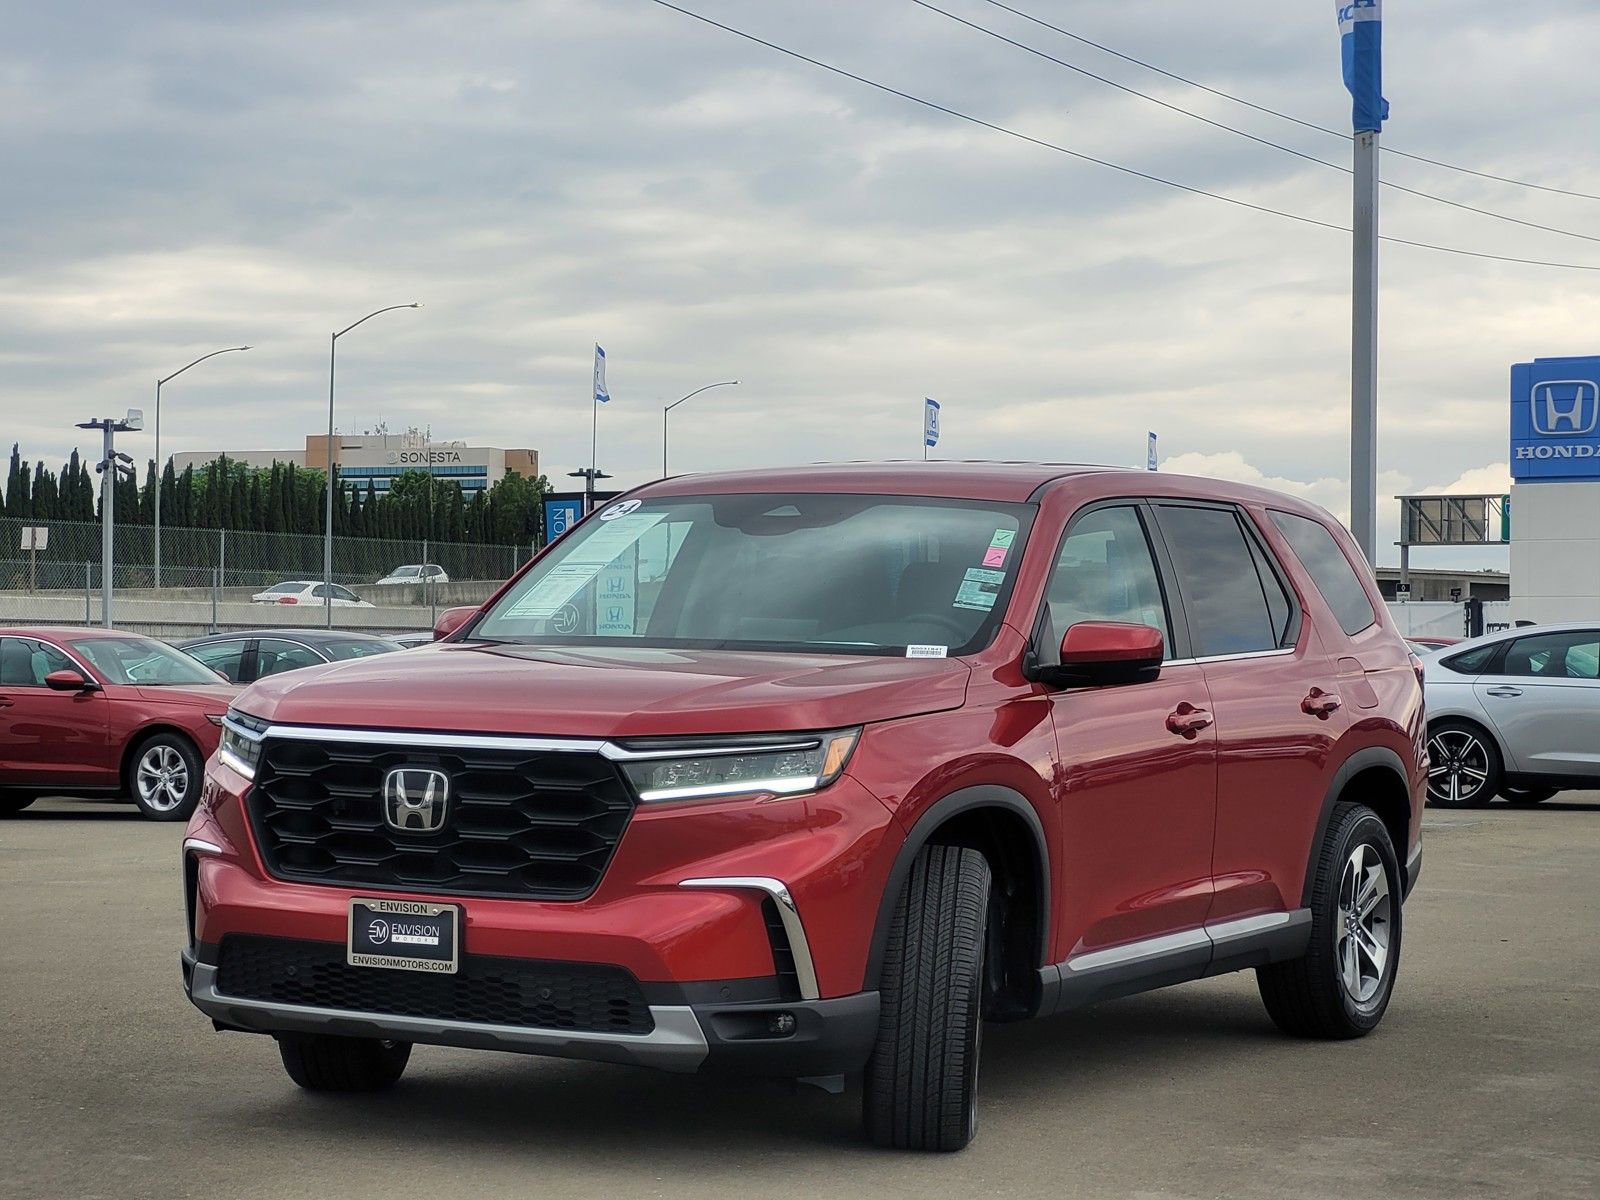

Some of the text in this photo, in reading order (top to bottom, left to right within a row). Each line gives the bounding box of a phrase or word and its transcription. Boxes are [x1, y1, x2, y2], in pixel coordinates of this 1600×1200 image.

[400, 452, 461, 462] SONESTA
[380, 902, 428, 914] ENVISION
[391, 923, 440, 937] ENVISION
[352, 956, 453, 972] ENVISIONMOTORS.COM
